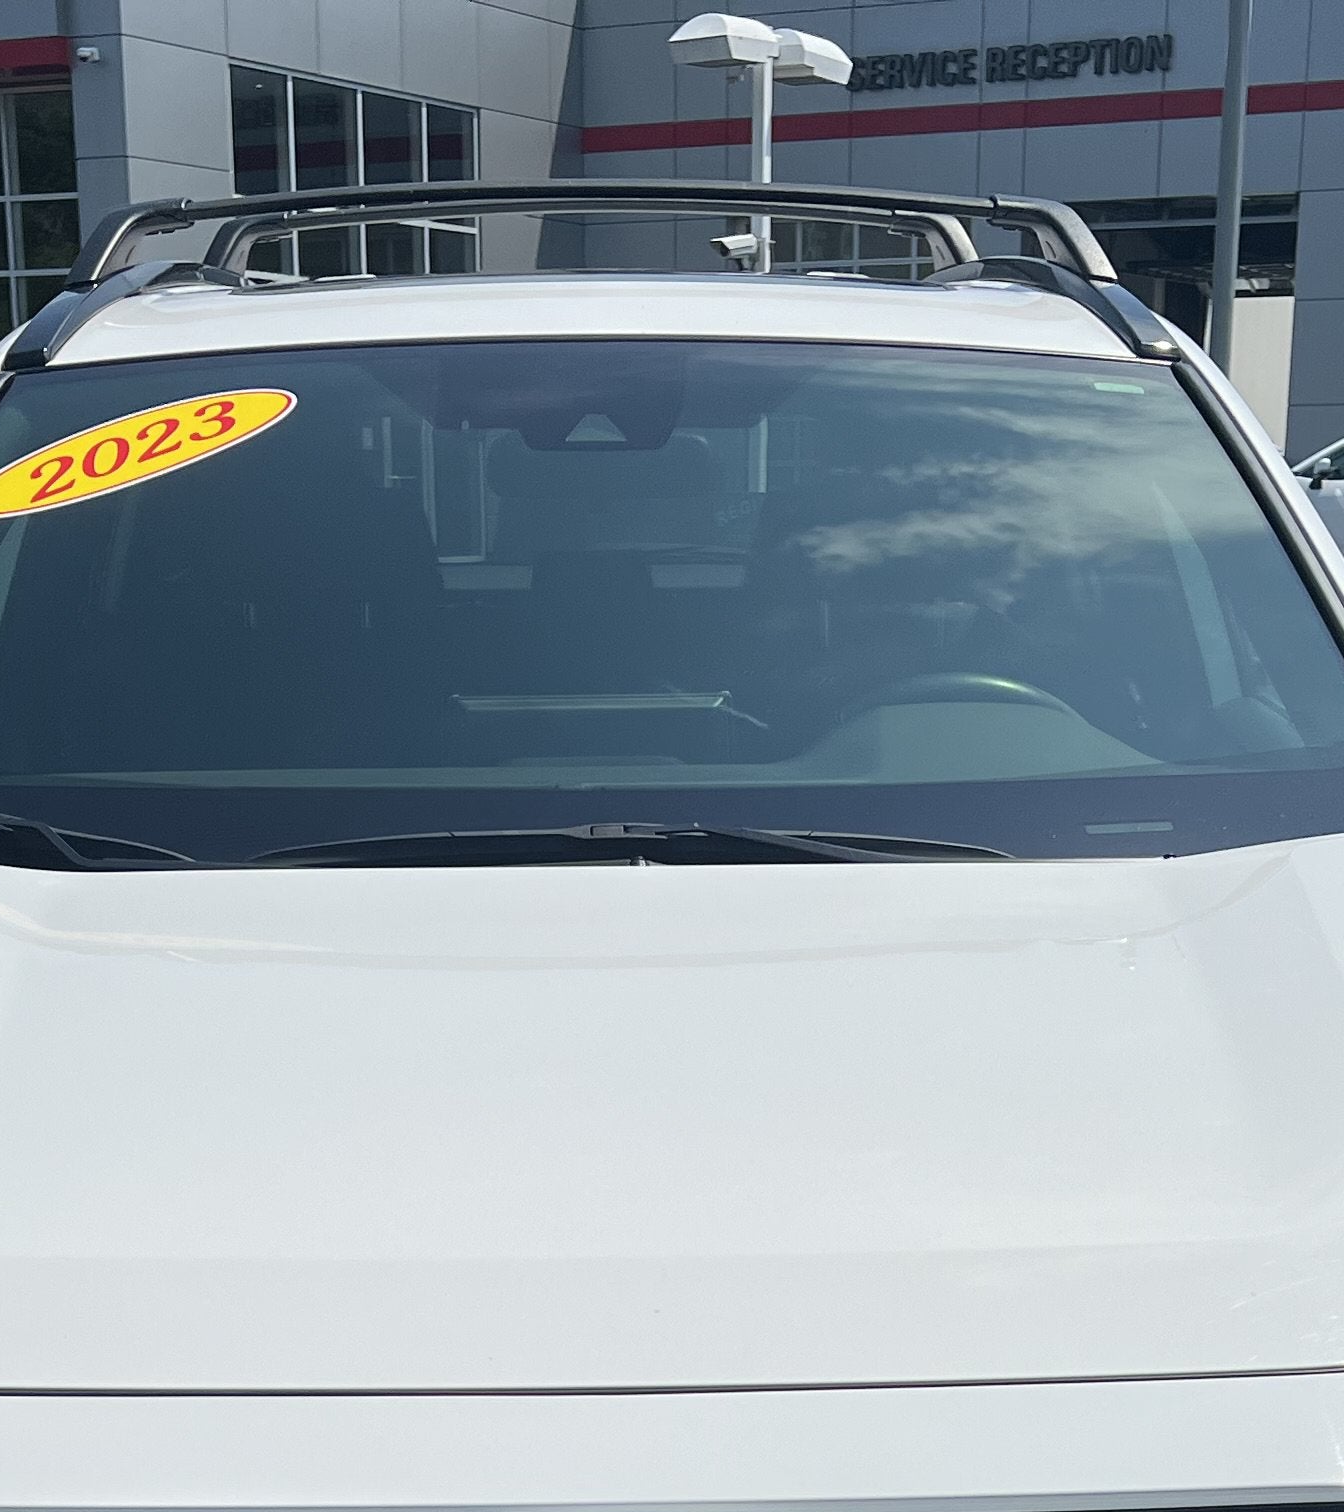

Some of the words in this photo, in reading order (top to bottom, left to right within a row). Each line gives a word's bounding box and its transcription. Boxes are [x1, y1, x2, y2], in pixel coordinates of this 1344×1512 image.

[847, 49, 978, 91] SERVICE
[986, 34, 1172, 82] RECEPTION
[30, 400, 236, 503] 2023
